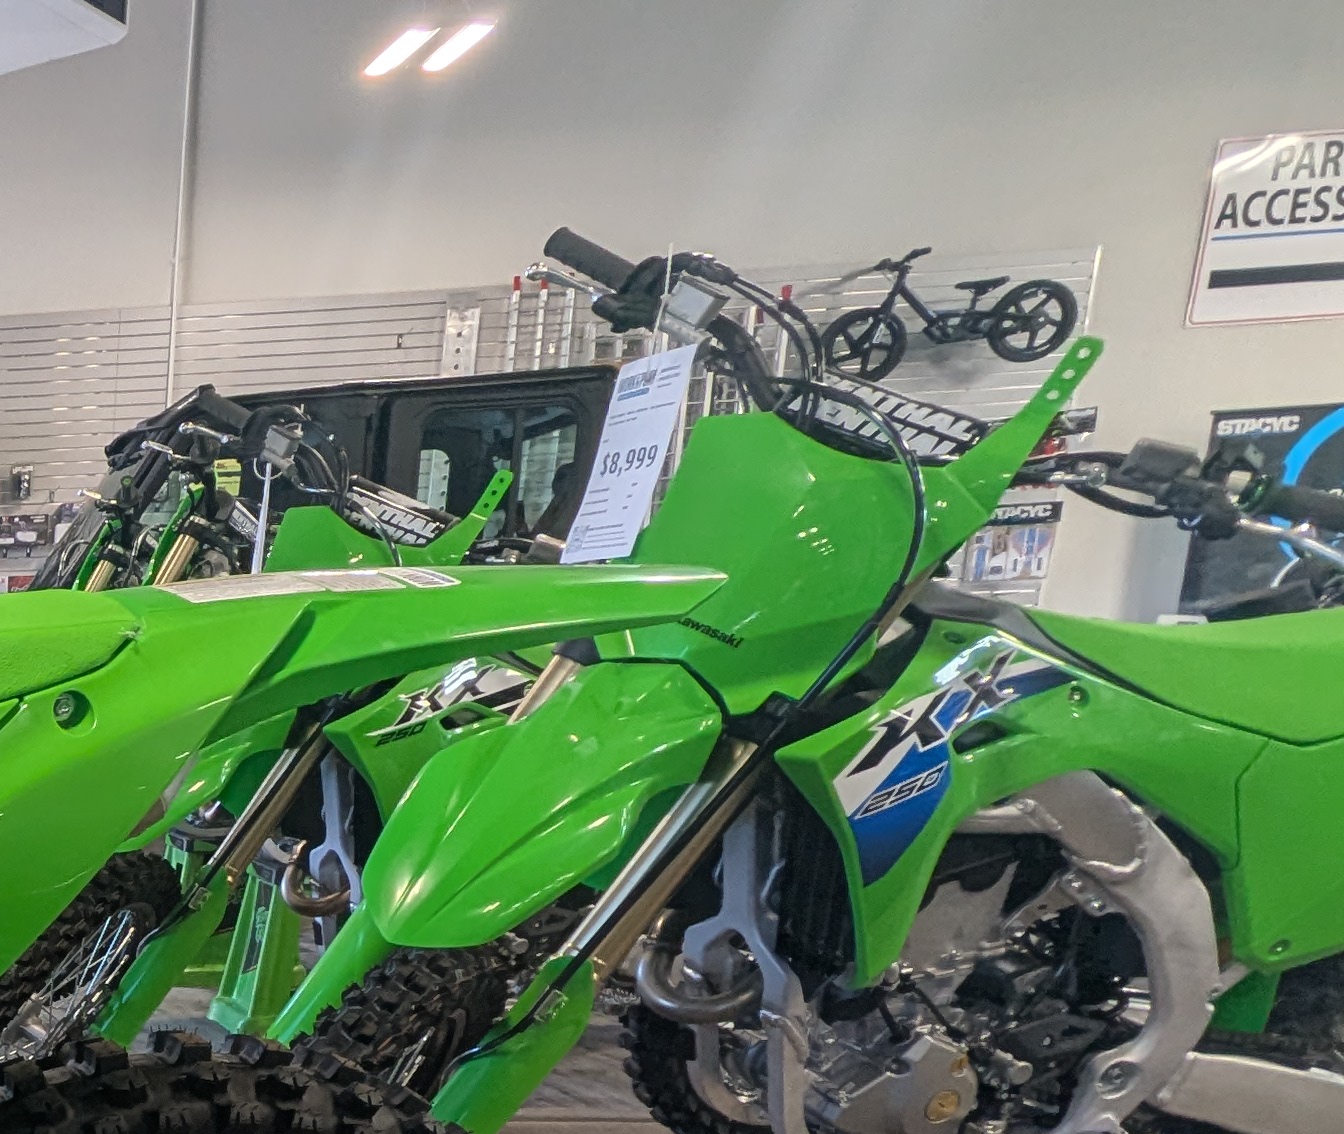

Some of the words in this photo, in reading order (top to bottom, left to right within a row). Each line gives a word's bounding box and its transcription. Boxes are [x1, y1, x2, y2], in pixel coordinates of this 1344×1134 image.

[1216, 415, 1301, 436] STACYC
[599, 444, 658, 478] $8,999
[847, 649, 1020, 778] KX
[375, 720, 428, 748] 250
[855, 761, 949, 820] 250
